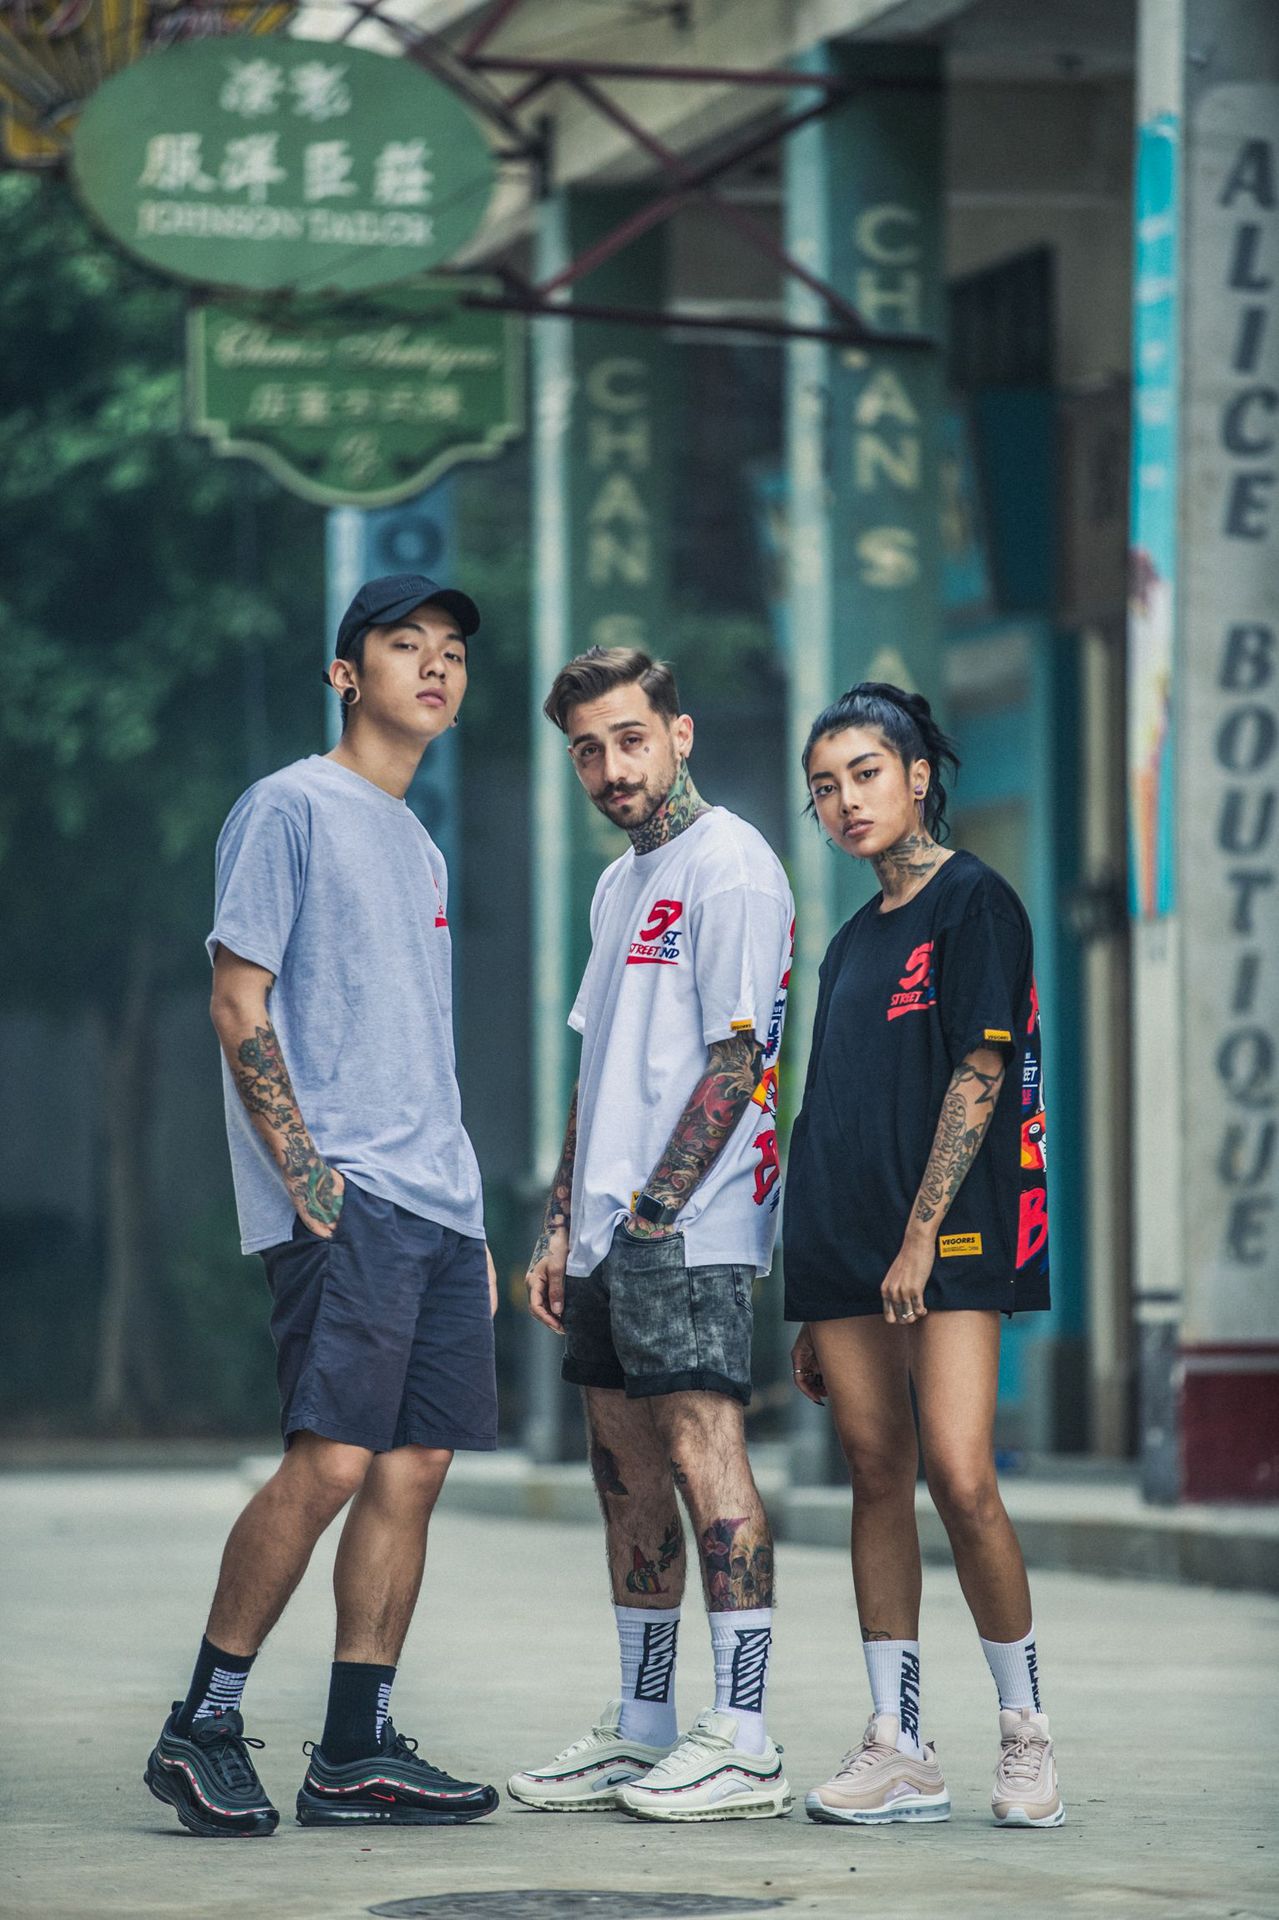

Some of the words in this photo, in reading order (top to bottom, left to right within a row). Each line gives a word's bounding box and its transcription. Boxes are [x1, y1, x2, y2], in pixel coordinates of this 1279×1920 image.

[304, 207, 435, 247] TAILOR
[1219, 139, 1277, 541] ALICE
[890, 990, 924, 1006] STREET
[1216, 622, 1279, 1267] BOUTIQUE
